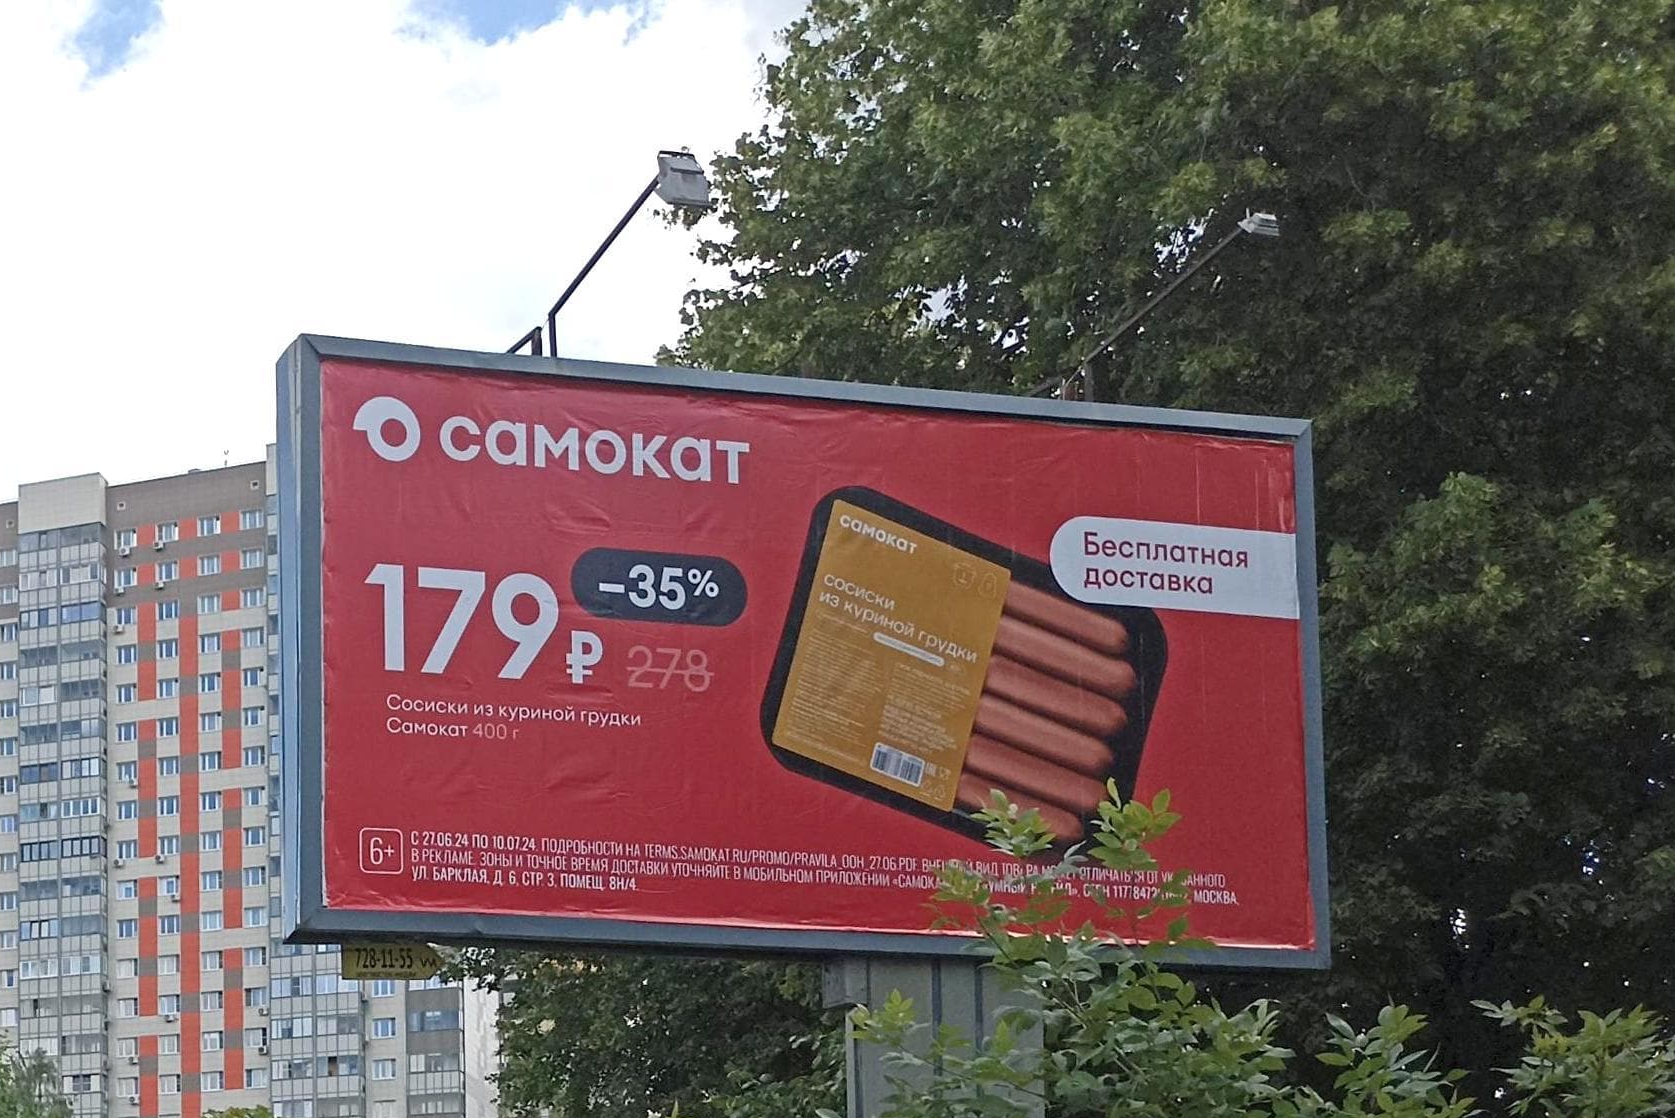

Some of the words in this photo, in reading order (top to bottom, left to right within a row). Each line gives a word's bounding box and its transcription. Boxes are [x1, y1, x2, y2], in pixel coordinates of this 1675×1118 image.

[439, 415, 750, 484] самокат
[839, 514, 917, 554] самокат
[1084, 531, 1249, 568] Бесплатная
[824, 574, 896, 611] сосиски
[1083, 567, 1213, 594] доставка
[819, 591, 839, 608] из
[843, 598, 915, 637] куриной
[918, 630, 977, 664] грудки
[626, 645, 714, 692] 278
[386, 693, 468, 714] Сосиски
[473, 704, 493, 717] из
[498, 705, 575, 722] куриной
[580, 711, 641, 729] грудки
[386, 717, 468, 737] Самокат
[472, 723, 507, 739] 400
[512, 727, 519, 739] г
[369, 837, 395, 865] 6+
[411, 831, 419, 845] С
[422, 832, 469, 848] 27.06.24
[472, 834, 489, 848] ПО
[541, 838, 623, 855] ПОДРОБНОСТИ
[625, 843, 641, 857] НА
[975, 861, 998, 876] ВИД
[411, 848, 419, 862] В
[480, 852, 512, 867] ЗОНЫ
[515, 854, 523, 868] И
[527, 854, 567, 870] ТОЧНОЕ
[571, 858, 608, 873] ВРЕМЯ
[611, 859, 668, 876] ДОСТАВКИ
[671, 861, 730, 880] УТОЧНЯЙТЕ
[733, 865, 741, 880] В
[744, 867, 813, 884] МОБИЛЬНОМ
[815, 869, 890, 887] ПРИЛОЖЕНИИ
